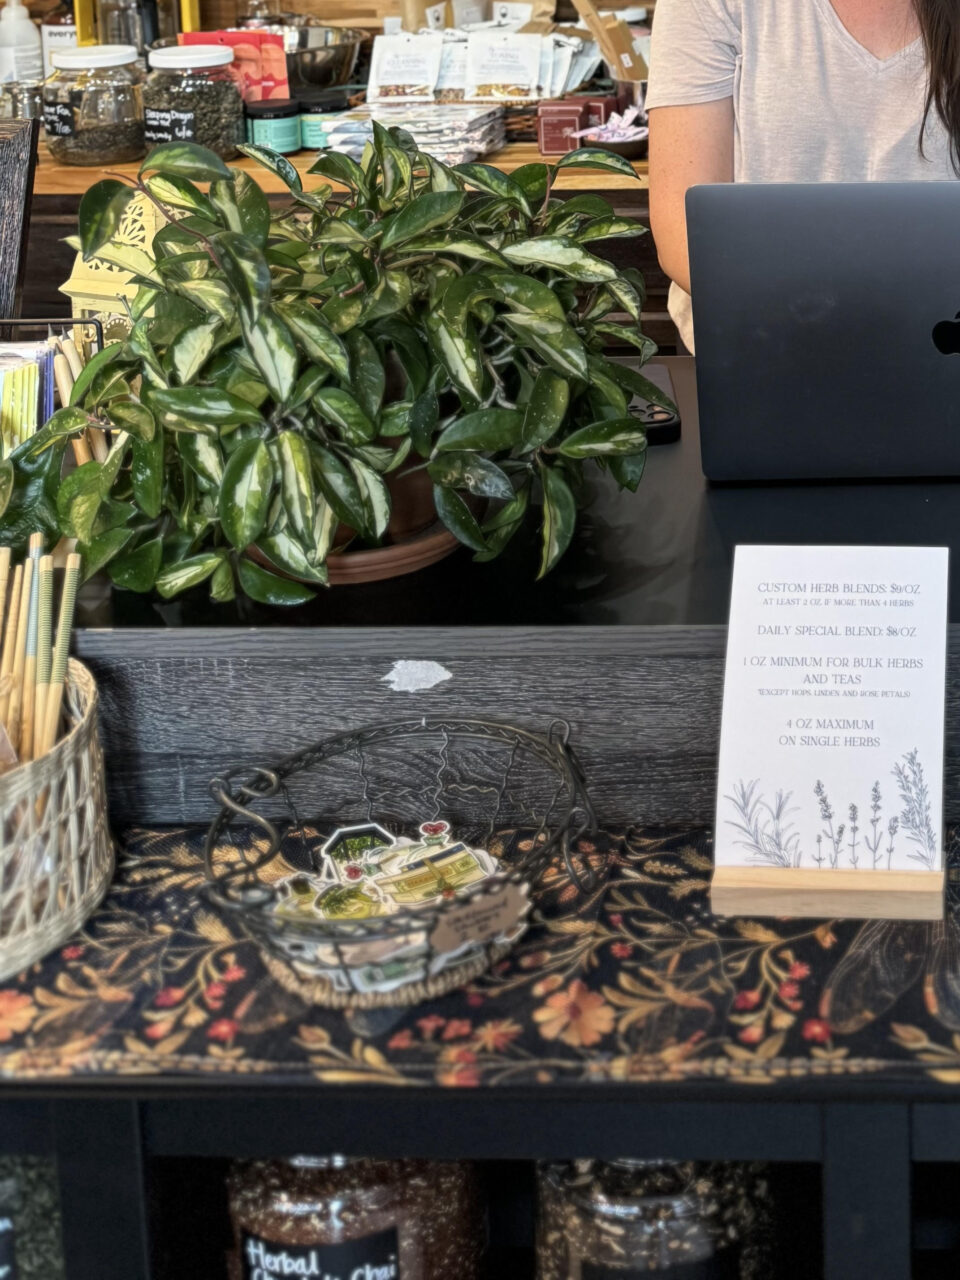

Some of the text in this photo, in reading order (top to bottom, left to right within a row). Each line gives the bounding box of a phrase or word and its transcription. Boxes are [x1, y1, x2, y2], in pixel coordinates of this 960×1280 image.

[171, 110, 194, 124] Dragon
[757, 583, 806, 593] CUSTOM
[810, 583, 839, 593] HERB
[843, 584, 887, 594] BLENDS:
[889, 599, 914, 607] HERBS
[757, 625, 917, 637] DAILY SPECIAL BLEND: $8/OZ
[744, 657, 923, 668] 1 OZ MINIMUM FOR BULK HERBS
[803, 674, 861, 684] AND TEAS
[814, 689, 840, 697] LINDEN
[787, 719, 874, 729] 4 OZ MAXIMUM
[779, 736, 881, 747] ON SINGLE HERBS
[246, 1238, 320, 1276] Herbal
[352, 1254, 397, 1280] Chai
